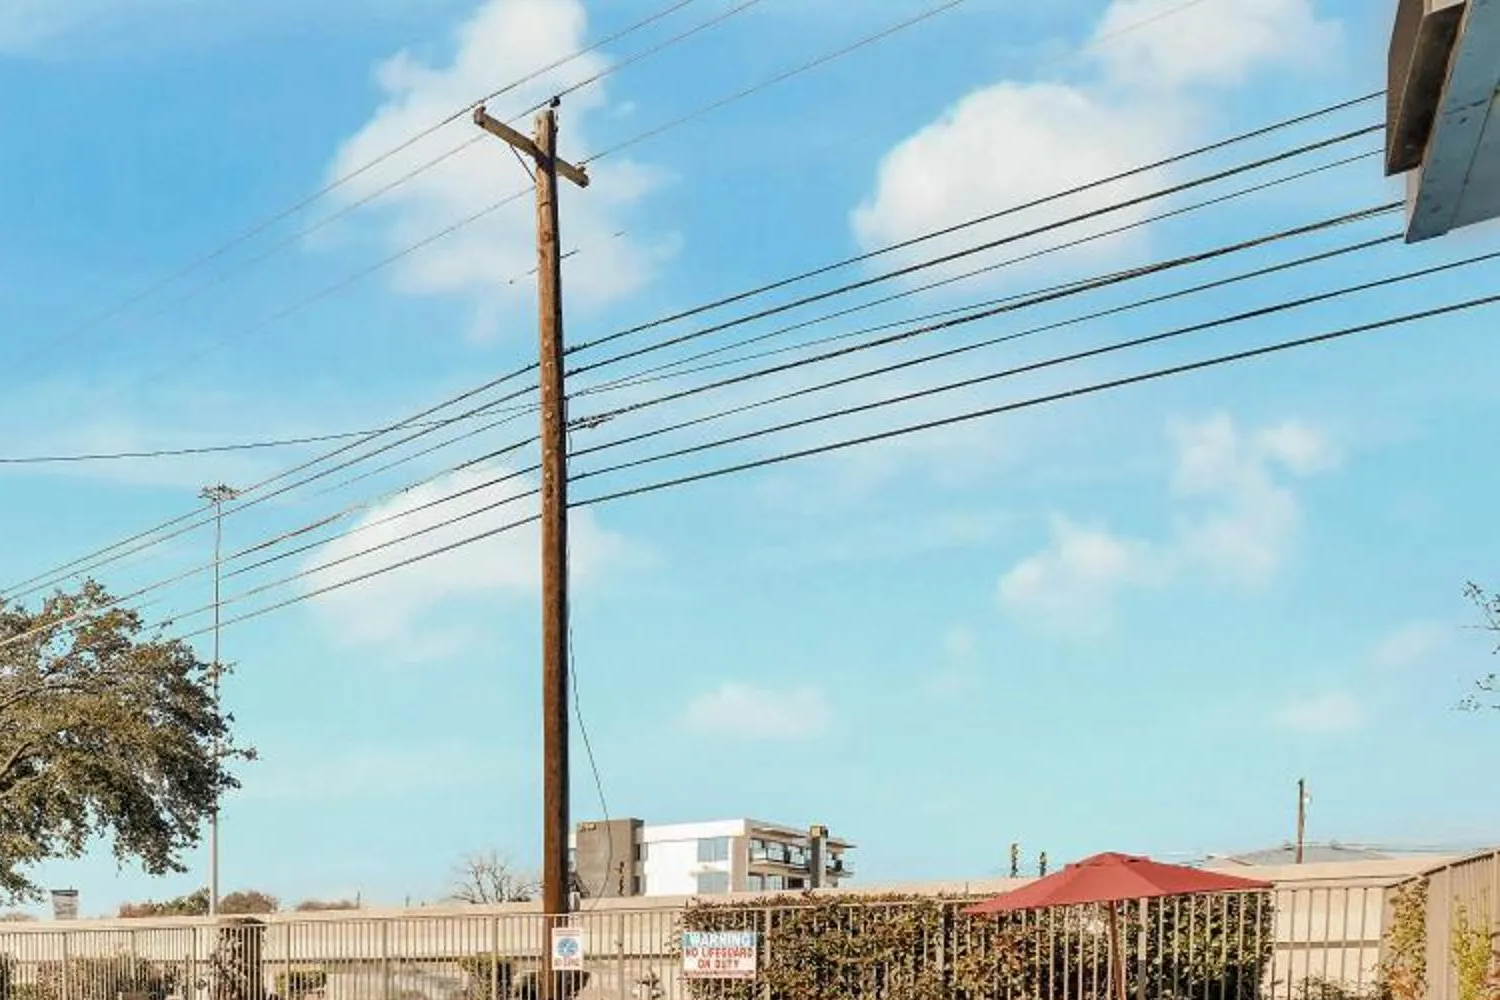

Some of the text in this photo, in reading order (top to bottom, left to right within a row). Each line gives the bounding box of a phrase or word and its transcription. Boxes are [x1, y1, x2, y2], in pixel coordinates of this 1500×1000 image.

[690, 933, 751, 947] WARNING
[685, 948, 754, 959] NO LIFEGUARD
[698, 959, 710, 969] ON
